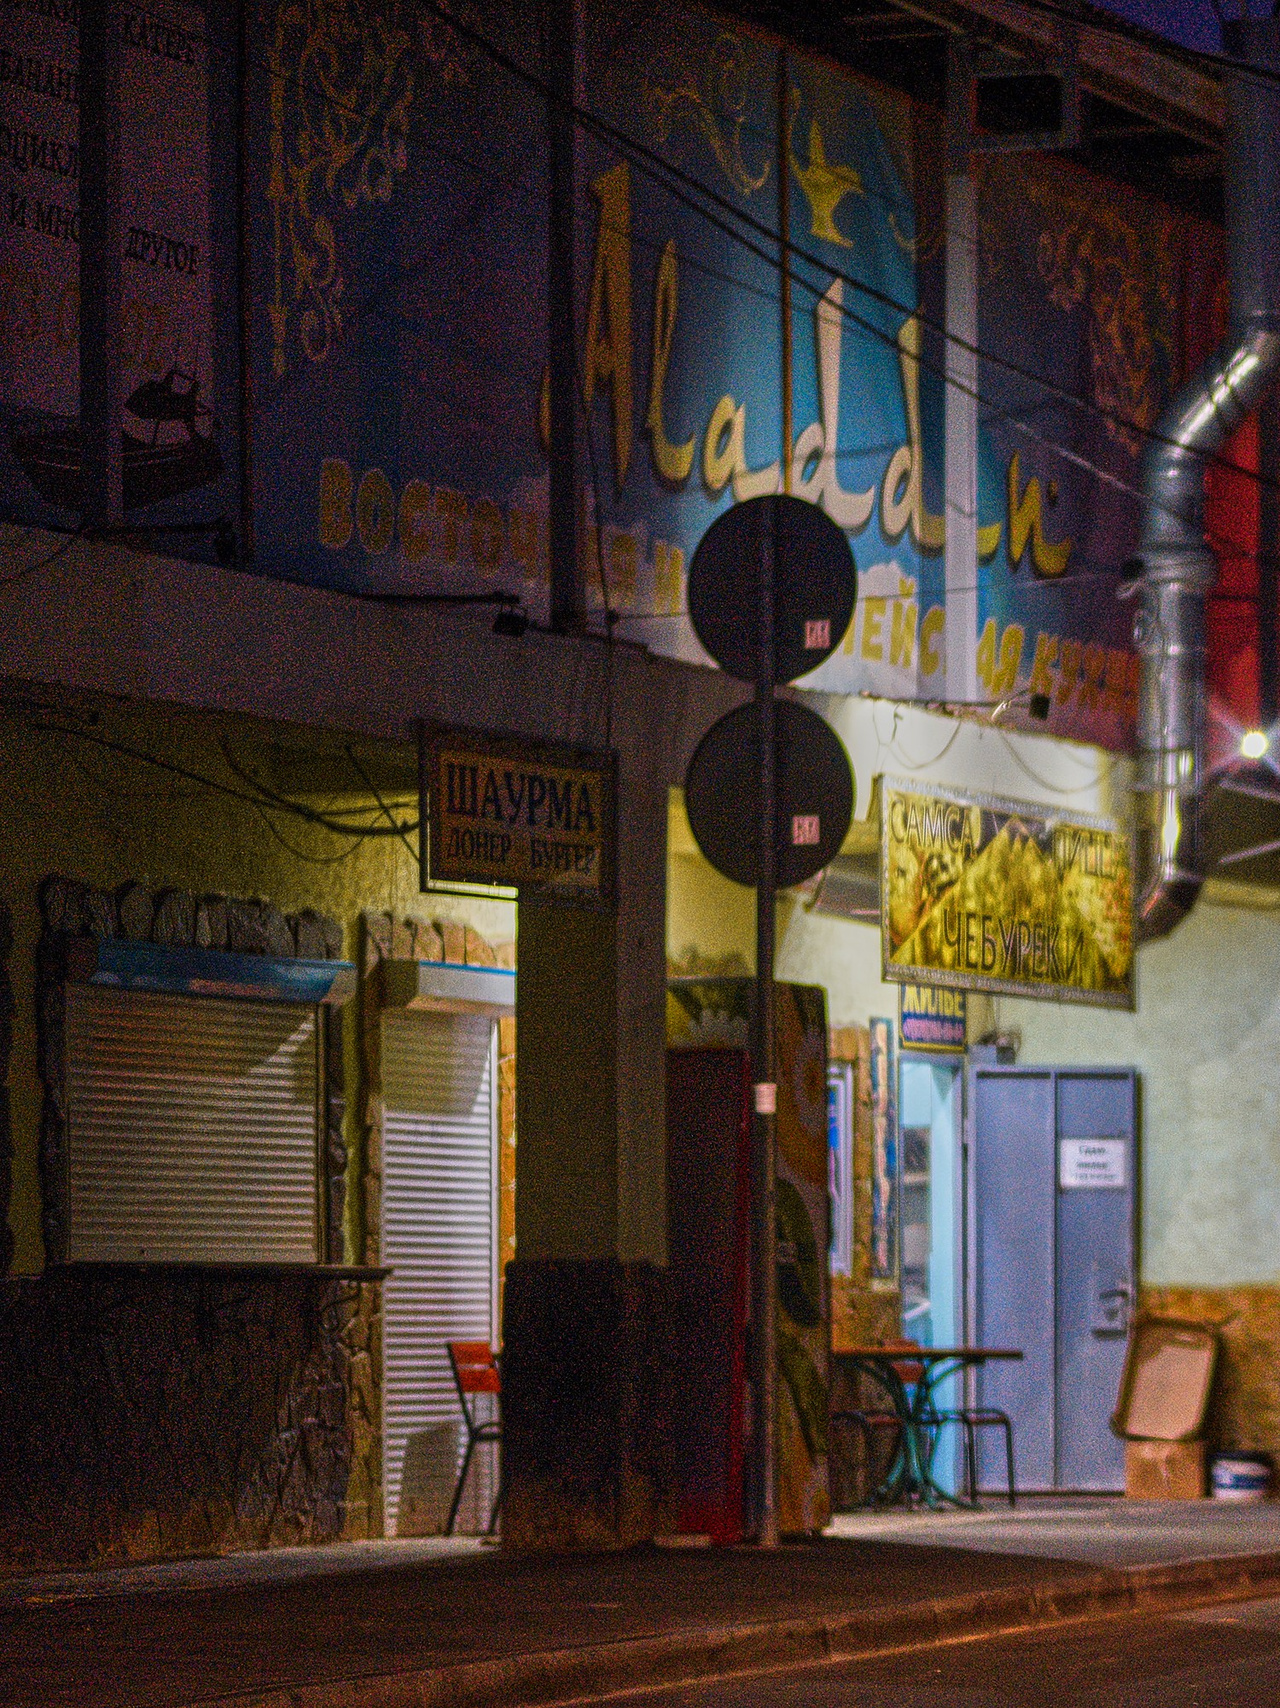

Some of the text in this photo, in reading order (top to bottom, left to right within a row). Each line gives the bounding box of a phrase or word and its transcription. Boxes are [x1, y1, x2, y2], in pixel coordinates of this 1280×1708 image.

[538, 160, 1073, 578] Aladdn
[446, 762, 597, 833] ШАУРМА
[889, 796, 980, 860] САМСА
[446, 827, 512, 864] ДОНЕР
[942, 907, 1085, 981] ЧЕБУРЕКИ
